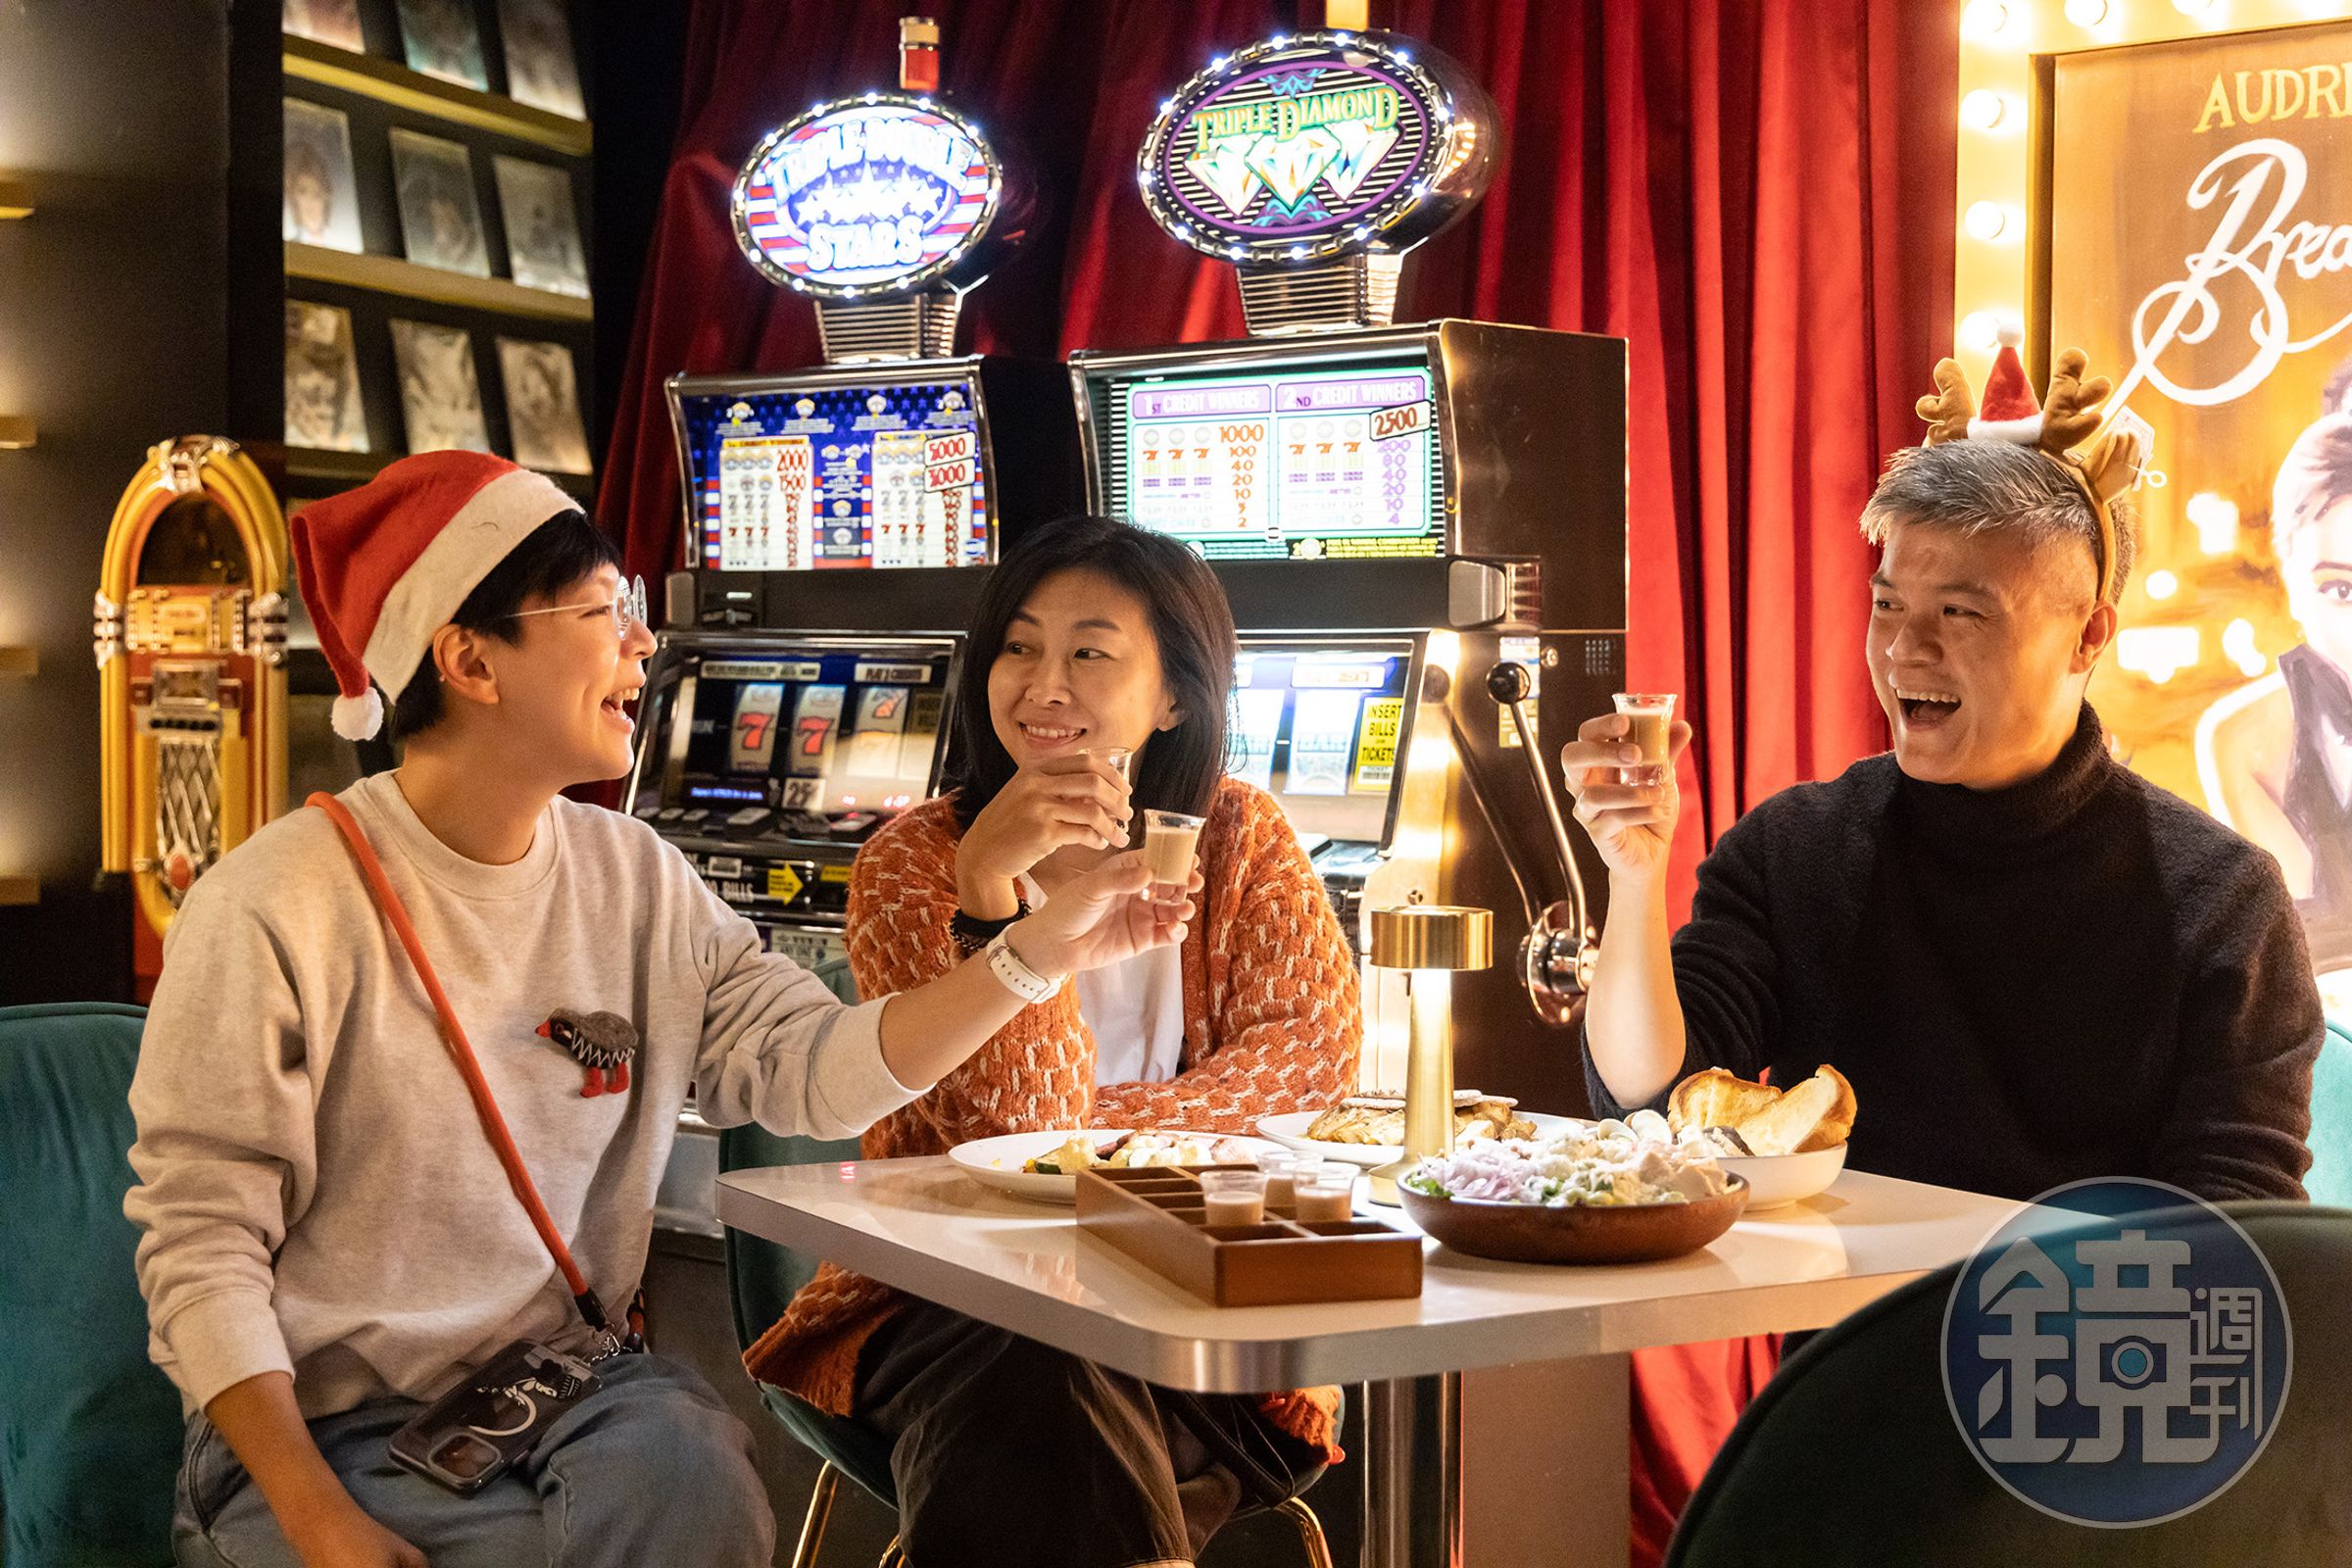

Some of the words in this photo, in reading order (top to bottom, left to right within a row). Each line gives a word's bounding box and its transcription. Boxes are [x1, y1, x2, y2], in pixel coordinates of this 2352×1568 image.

[1193, 102, 1273, 151] TRIPLE
[1275, 85, 1399, 142] DIAMOND
[807, 215, 924, 271] STARS
[1312, 384, 1357, 406] CREDIT
[1357, 380, 1417, 403] WINNERS
[1375, 408, 1418, 437] 2500
[1219, 423, 1264, 443] 1000
[1229, 446, 1256, 458] 100
[777, 449, 808, 471] 2000
[1232, 461, 1253, 471] 40
[1232, 474, 1253, 486] 20
[1234, 488, 1251, 500] 10
[1368, 705, 1402, 718] INSERT
[1369, 722, 1396, 736] BILLS
[1362, 747, 1396, 761] TICKETS
